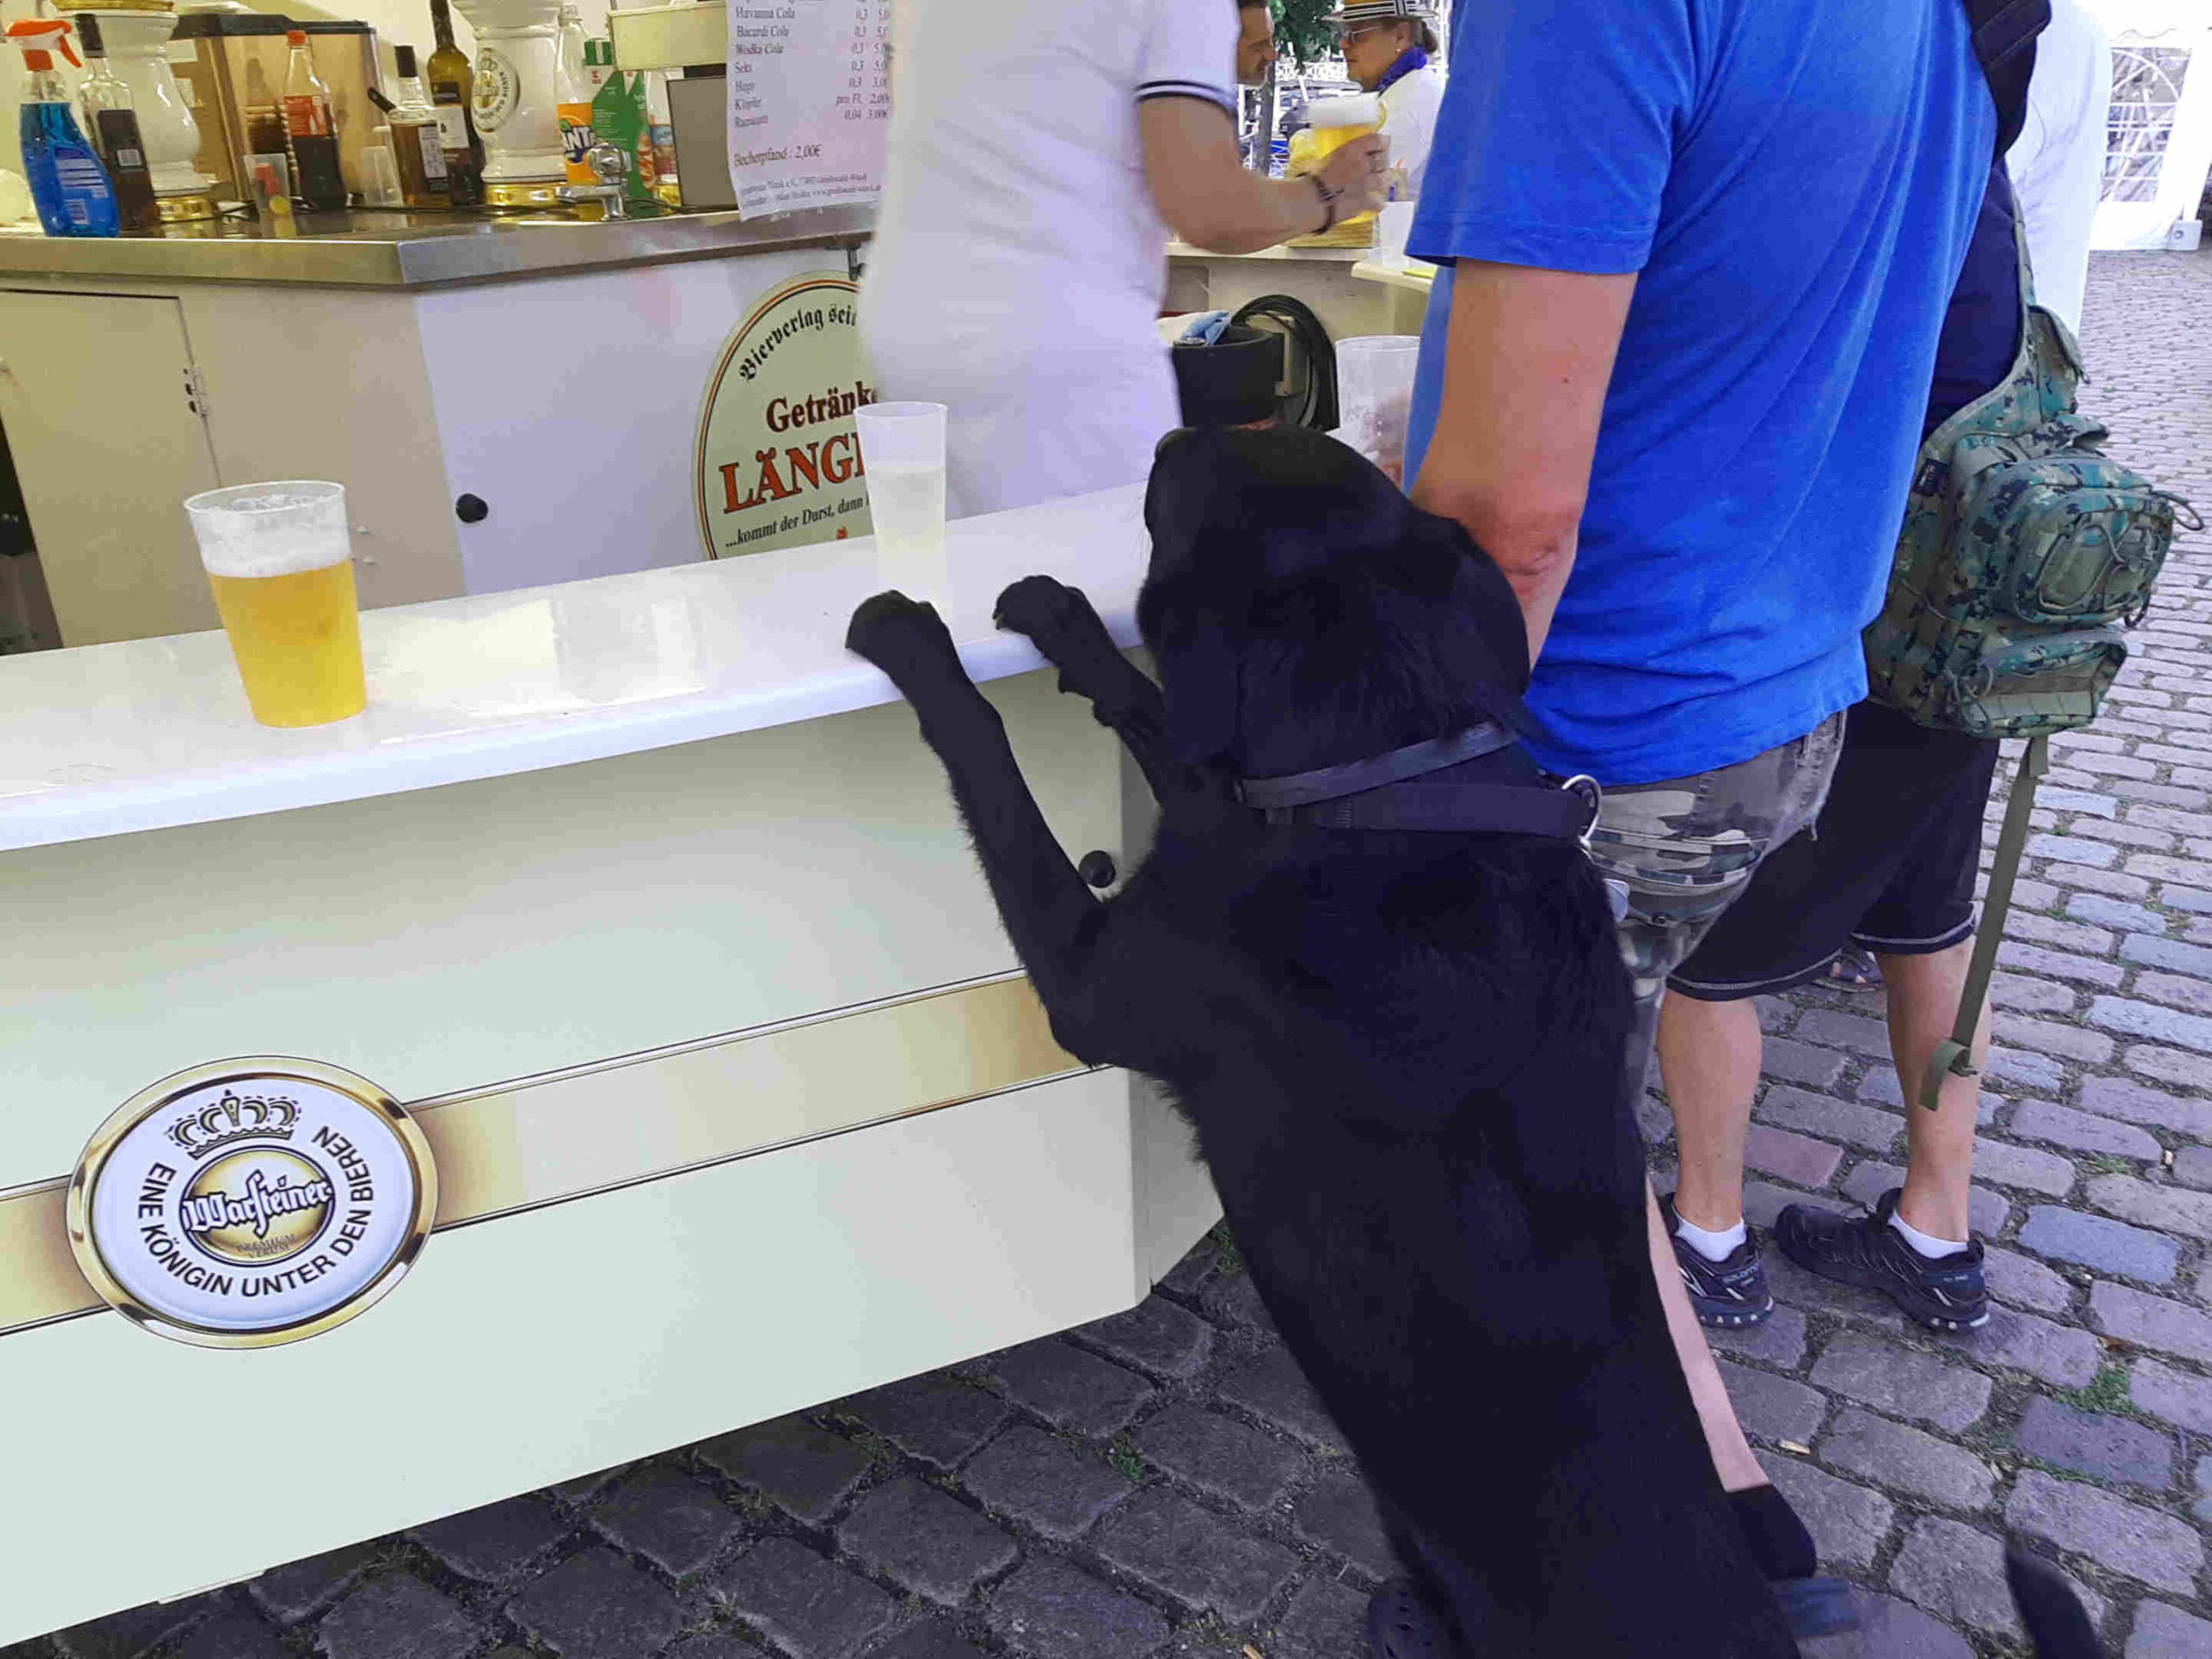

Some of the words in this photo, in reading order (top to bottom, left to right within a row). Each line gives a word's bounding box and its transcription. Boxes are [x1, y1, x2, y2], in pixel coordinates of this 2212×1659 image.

[739, 308, 823, 382] Bierverlag
[779, 515, 798, 532] der
[837, 495, 863, 514] dann
[137, 1161, 178, 1219] EINE
[310, 1125, 374, 1202] BIEREN
[180, 1168, 334, 1239] Warsteiner
[329, 1209, 372, 1257] DEN
[140, 1223, 233, 1296] KÖNIGIN
[240, 1254, 338, 1297] UNTER
